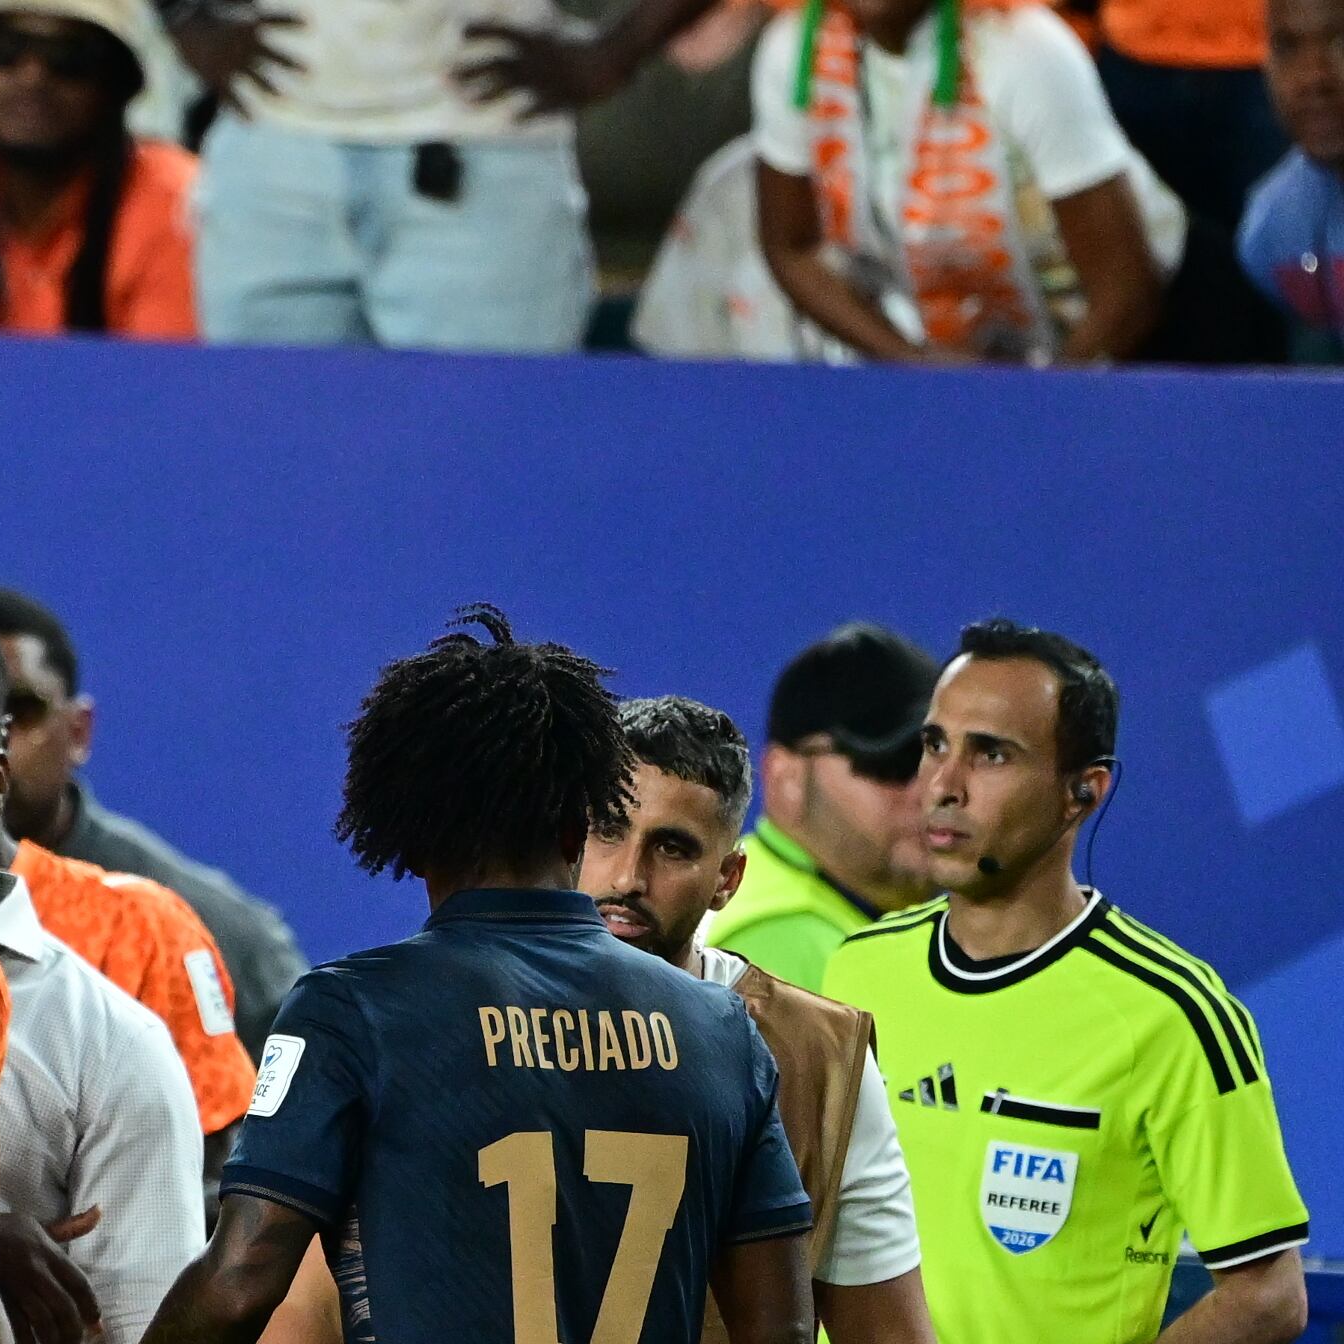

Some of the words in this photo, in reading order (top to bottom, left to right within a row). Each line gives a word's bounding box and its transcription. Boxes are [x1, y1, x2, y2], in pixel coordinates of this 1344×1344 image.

[478, 1005, 679, 1072] PRECIADO
[992, 1149, 1066, 1184] FIFA
[987, 1192, 1062, 1216] REFEREE
[1001, 1230, 1037, 1248] 2026
